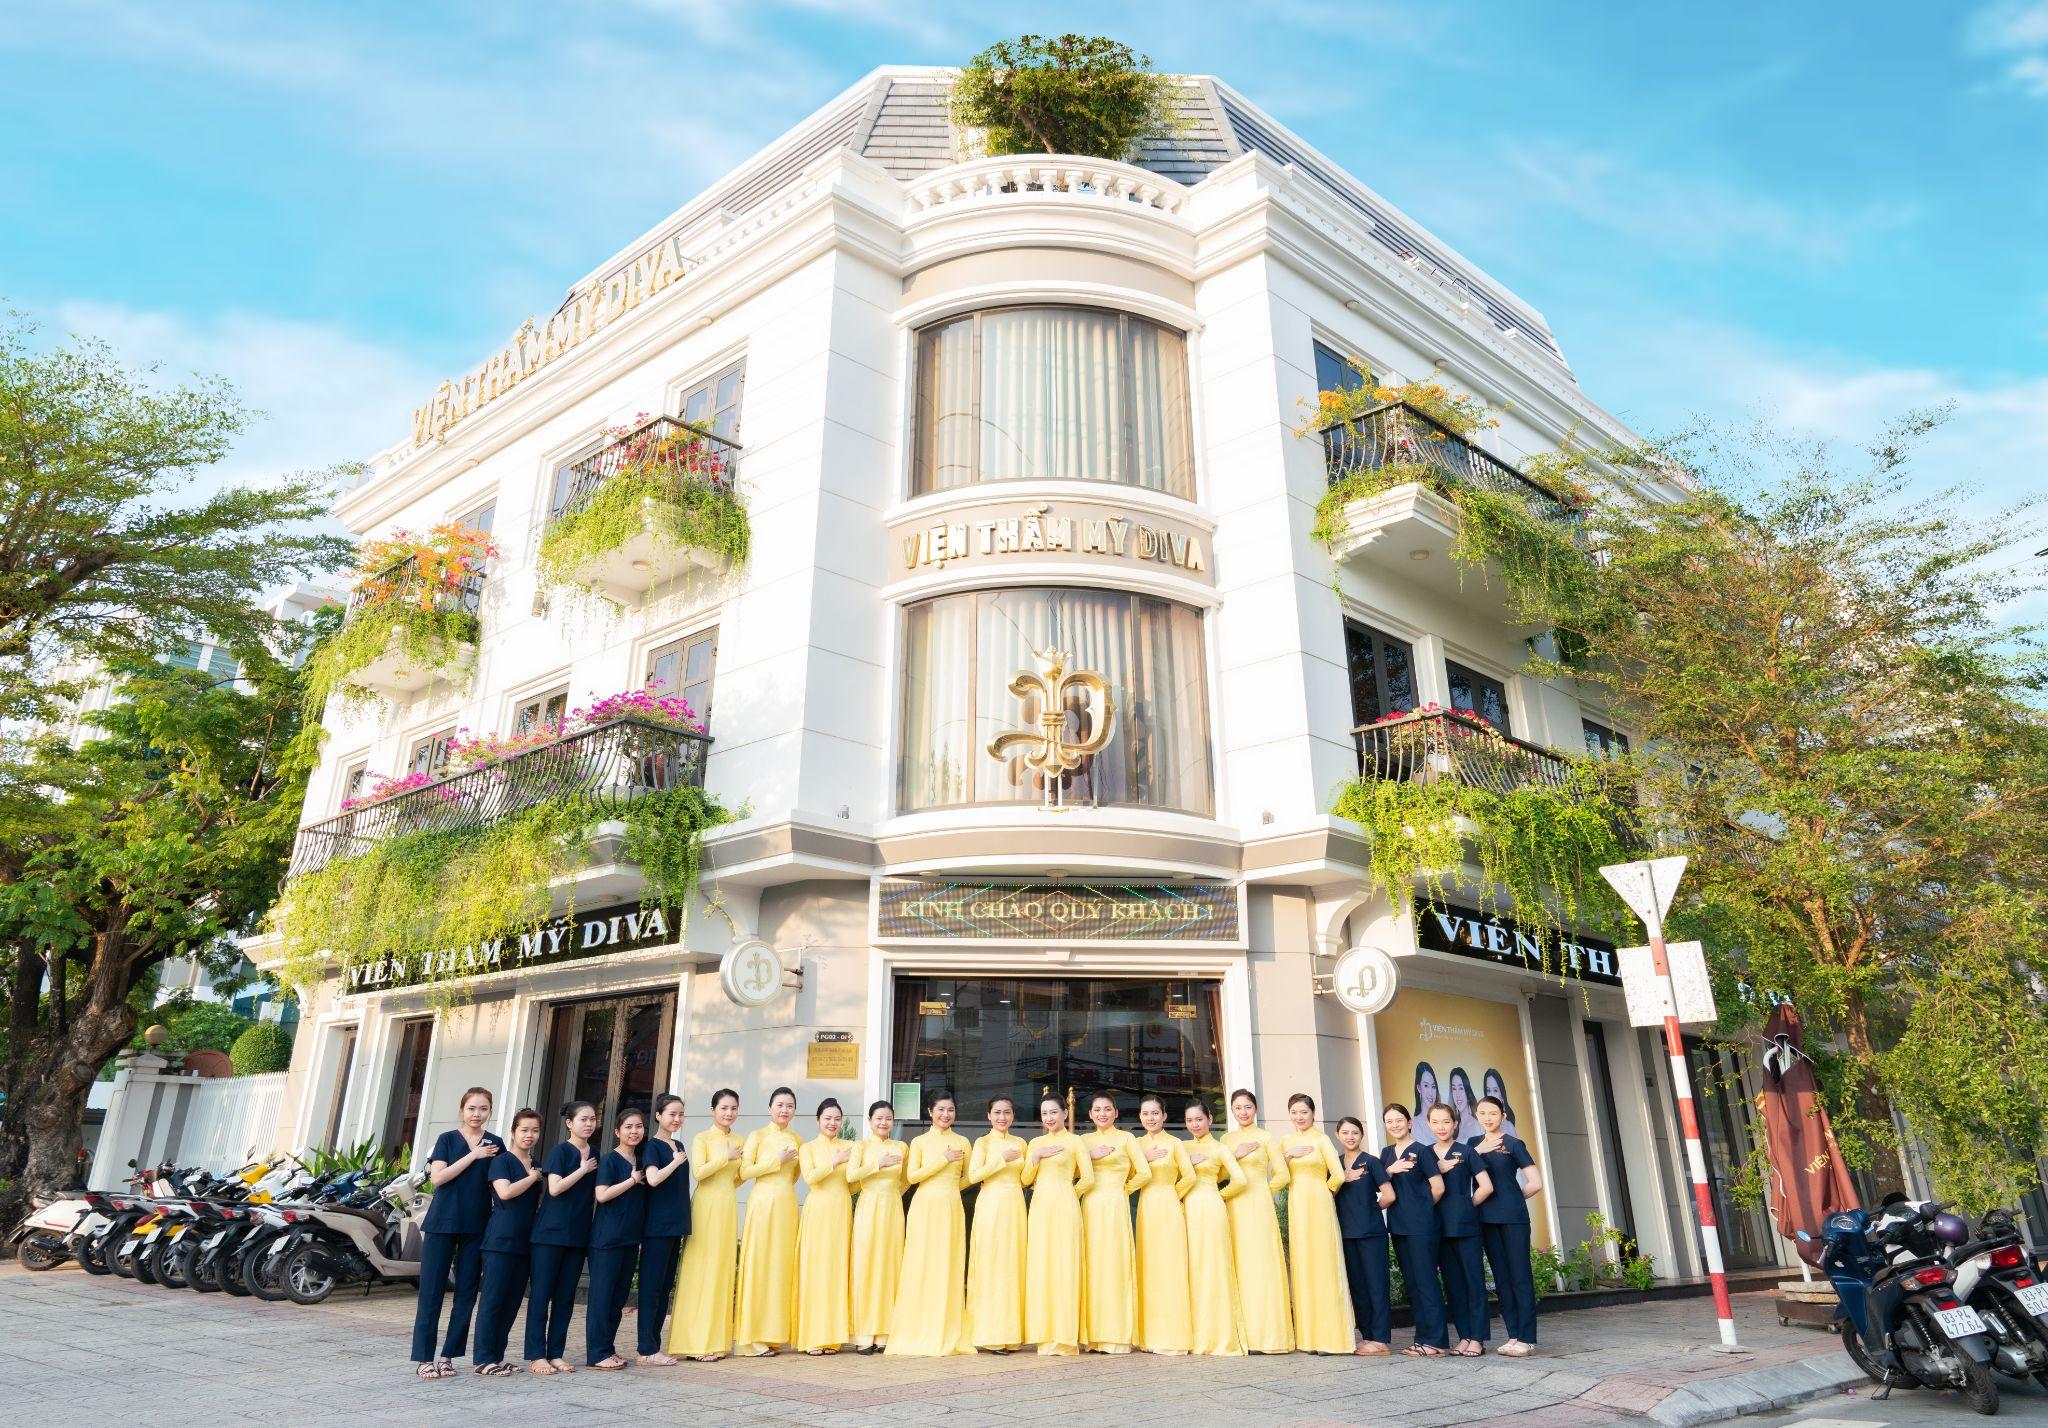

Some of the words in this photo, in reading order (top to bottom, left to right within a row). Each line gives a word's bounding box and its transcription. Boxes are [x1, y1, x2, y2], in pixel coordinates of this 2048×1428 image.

[603, 236, 686, 324] DIVA
[901, 520, 969, 569] VIỆN
[975, 503, 1072, 554] THẨM
[1082, 513, 1129, 555] MỸ
[1137, 524, 1205, 571] DIVA
[517, 918, 570, 960] MỸ
[581, 907, 669, 949] DIVA
[897, 897, 964, 918] KÍNH
[970, 897, 1043, 919] CHÀO
[1049, 899, 1105, 923] QUÝ
[1435, 913, 1542, 961] VIỆN
[1941, 1309, 1971, 1324] 83-P4
[2027, 1301, 2048, 1314] 504
